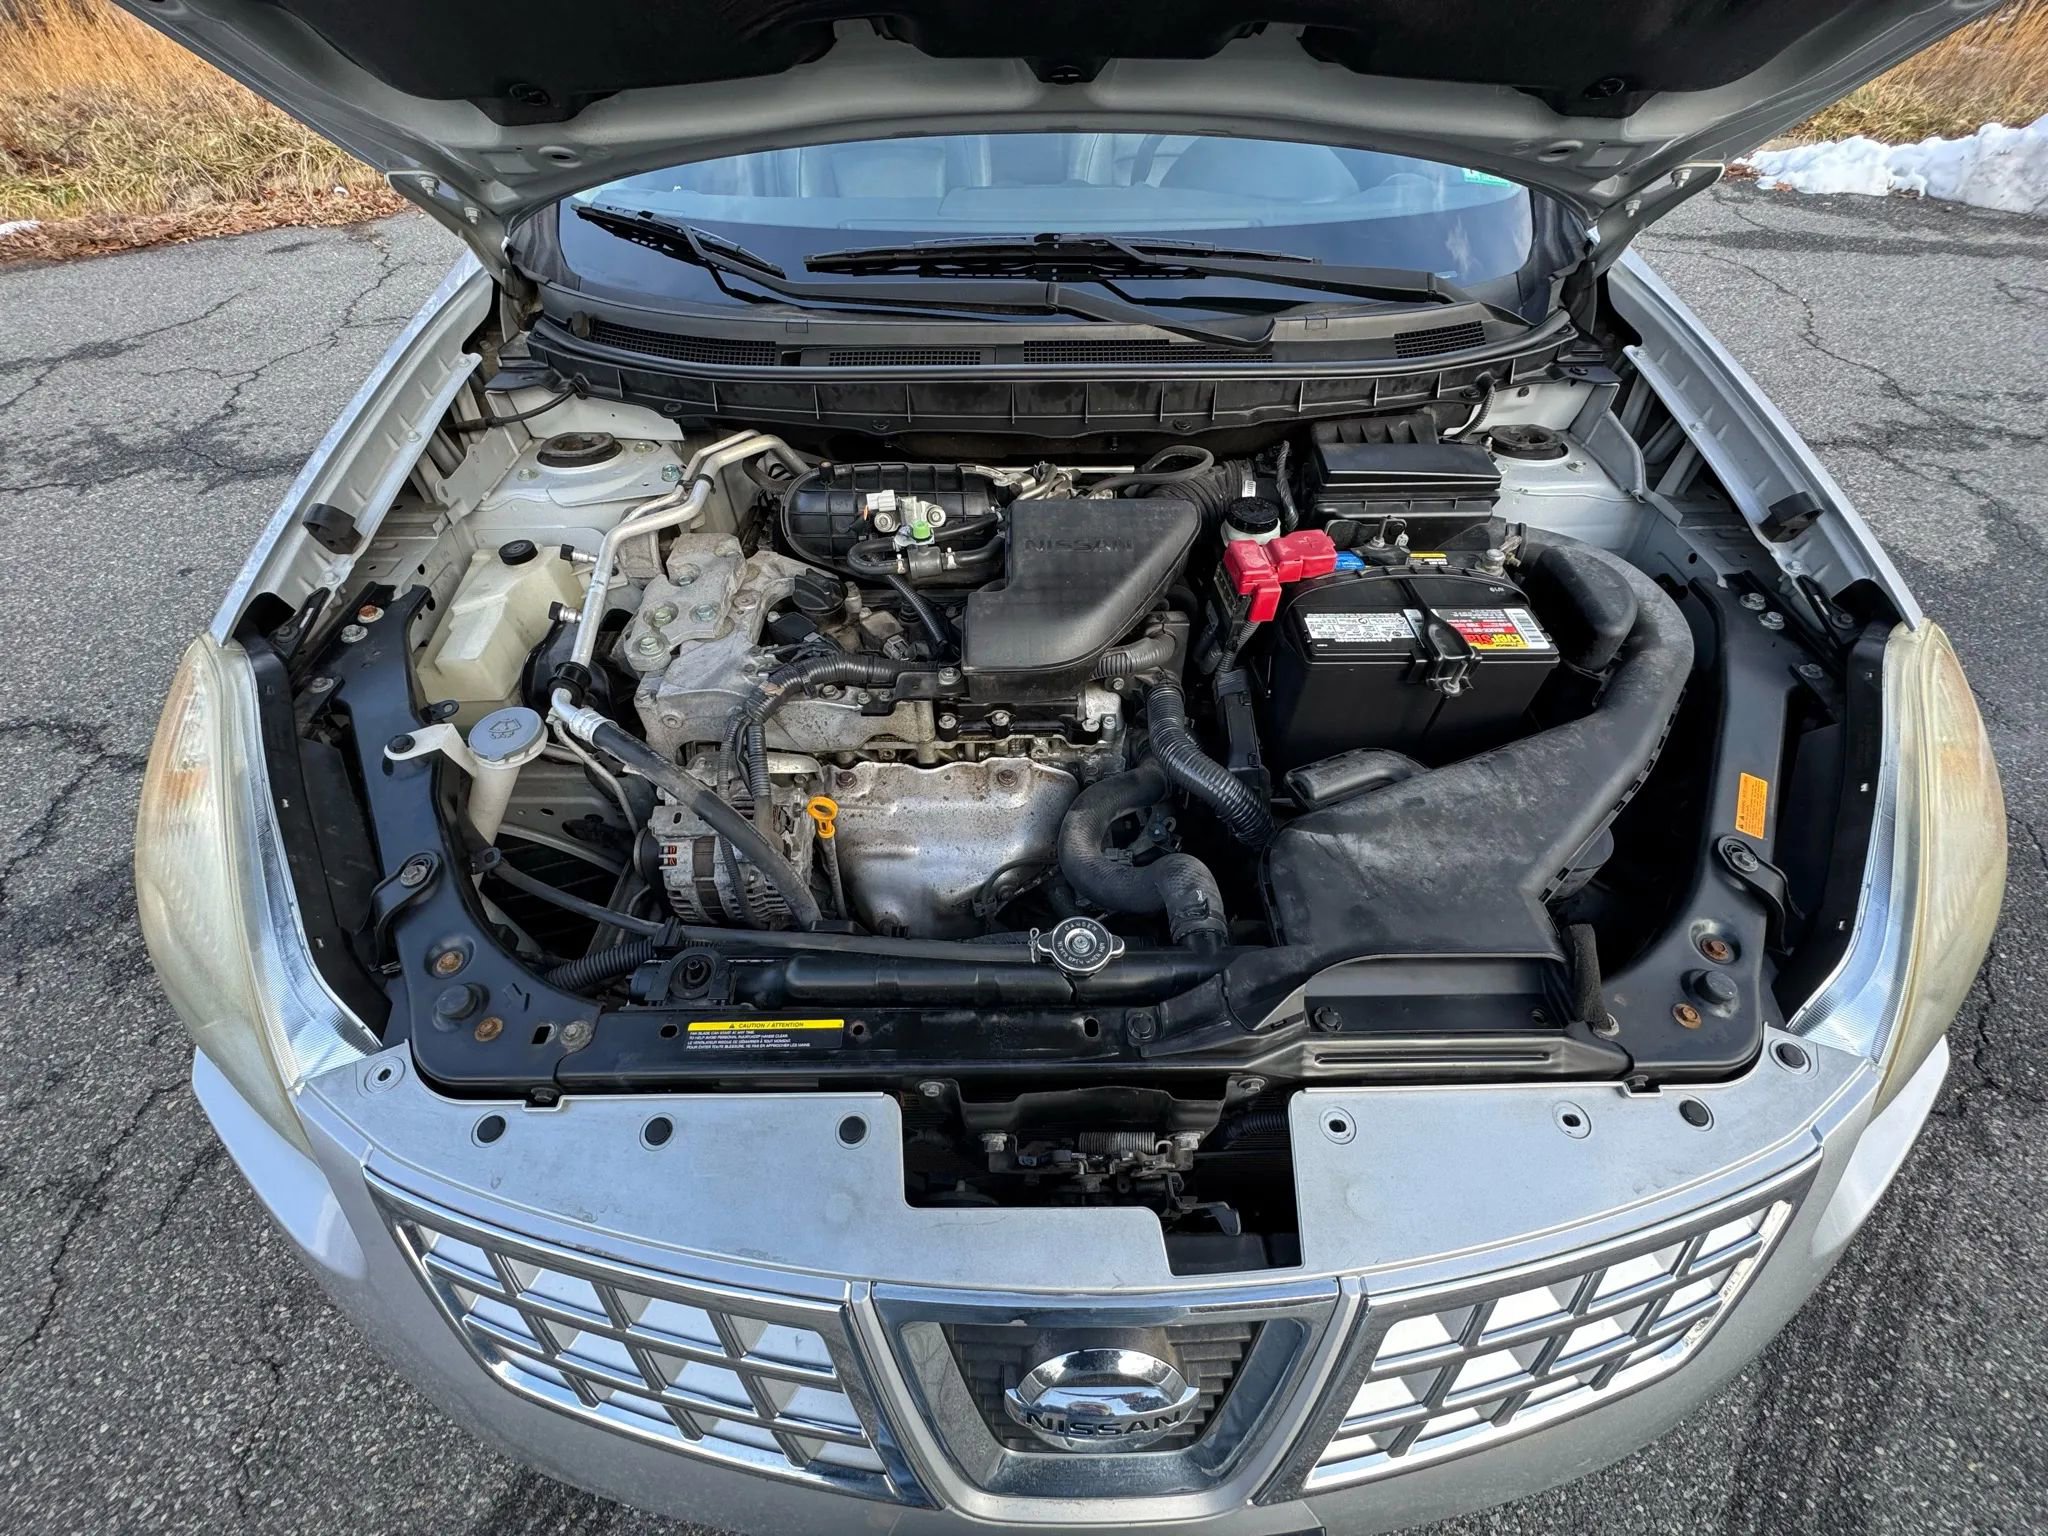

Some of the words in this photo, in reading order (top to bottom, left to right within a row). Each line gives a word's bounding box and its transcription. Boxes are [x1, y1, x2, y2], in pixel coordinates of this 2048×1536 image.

[1024, 539, 1134, 552] NISSAN
[771, 1021, 804, 1029] ATTENTION
[1026, 1410, 1181, 1436] NISSAN
